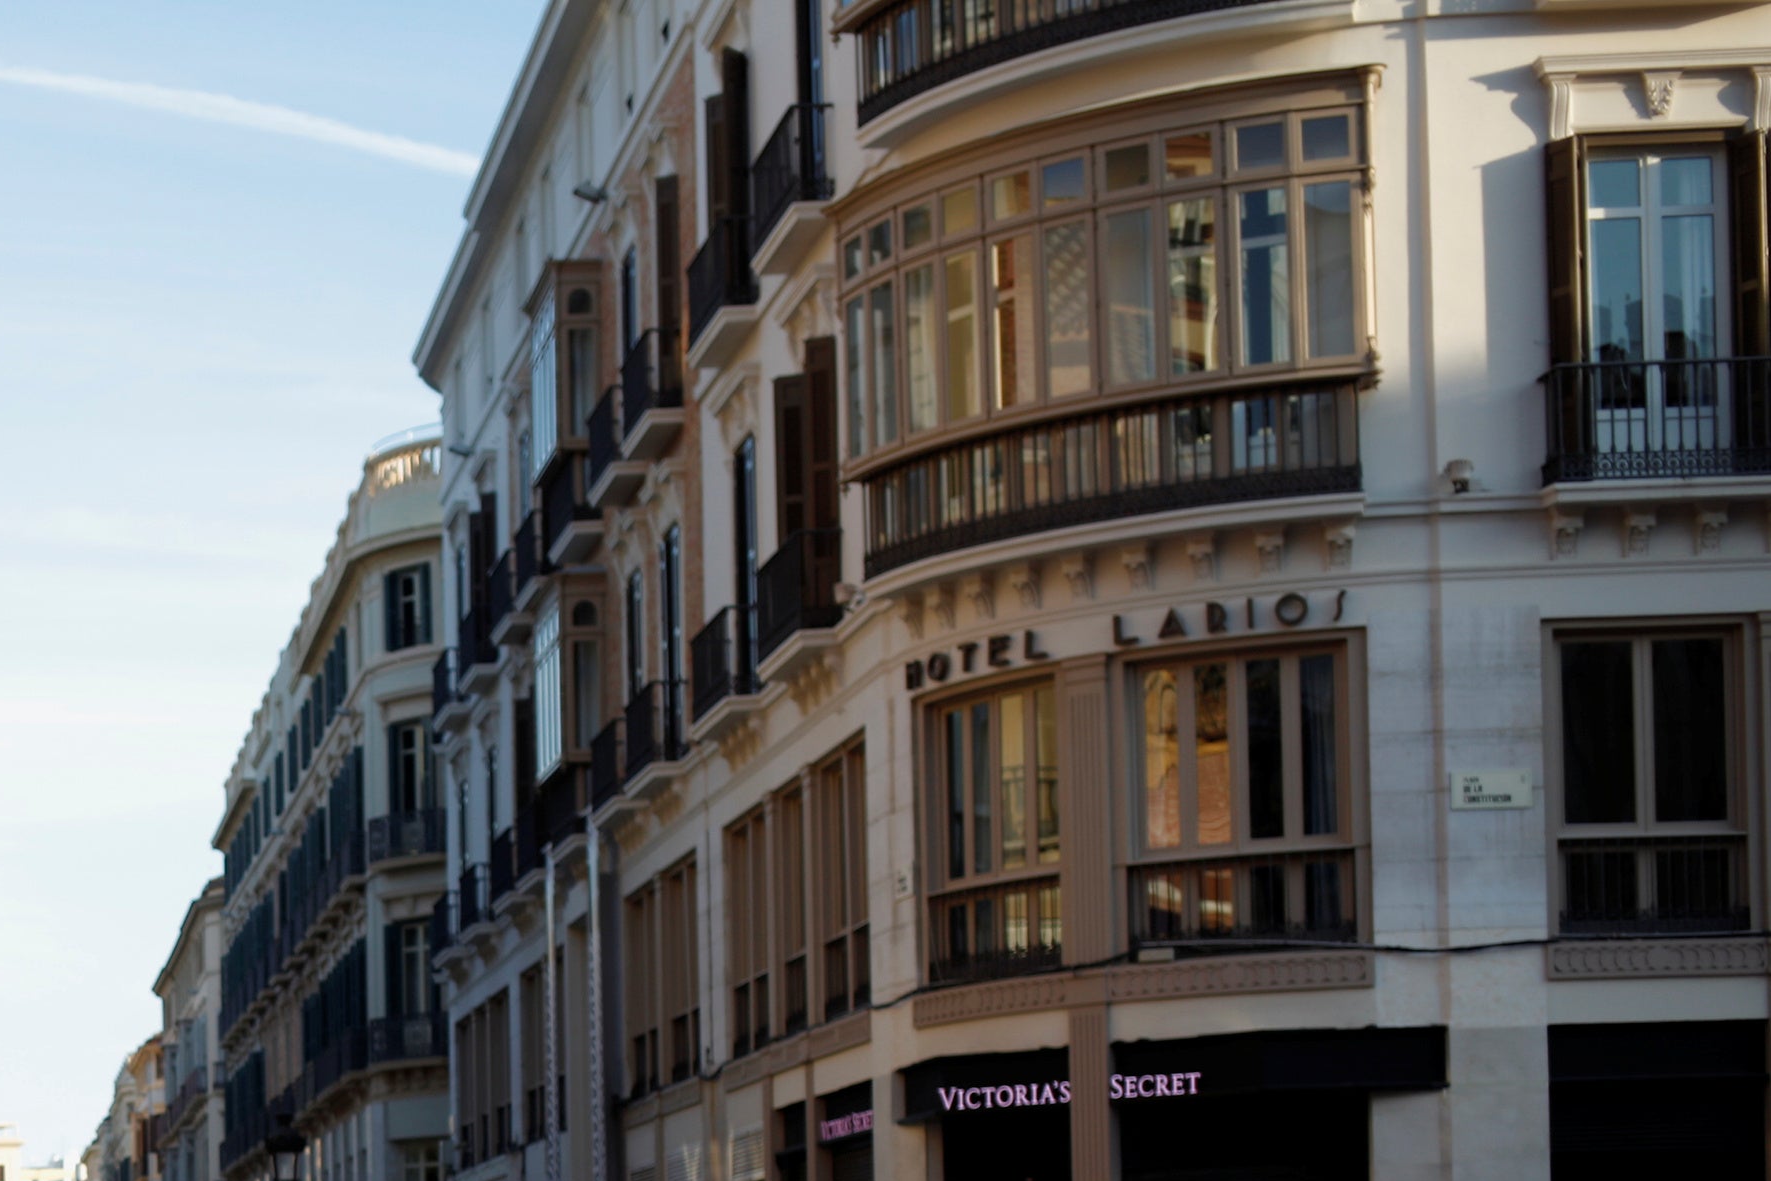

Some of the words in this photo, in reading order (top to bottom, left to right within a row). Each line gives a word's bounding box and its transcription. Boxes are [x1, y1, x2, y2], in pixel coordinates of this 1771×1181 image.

[905, 629, 1050, 691] HOTEL
[1112, 589, 1348, 647] LARIOS
[937, 1080, 1072, 1112] VICTORIA'S
[1109, 1071, 1202, 1100] SECRET
